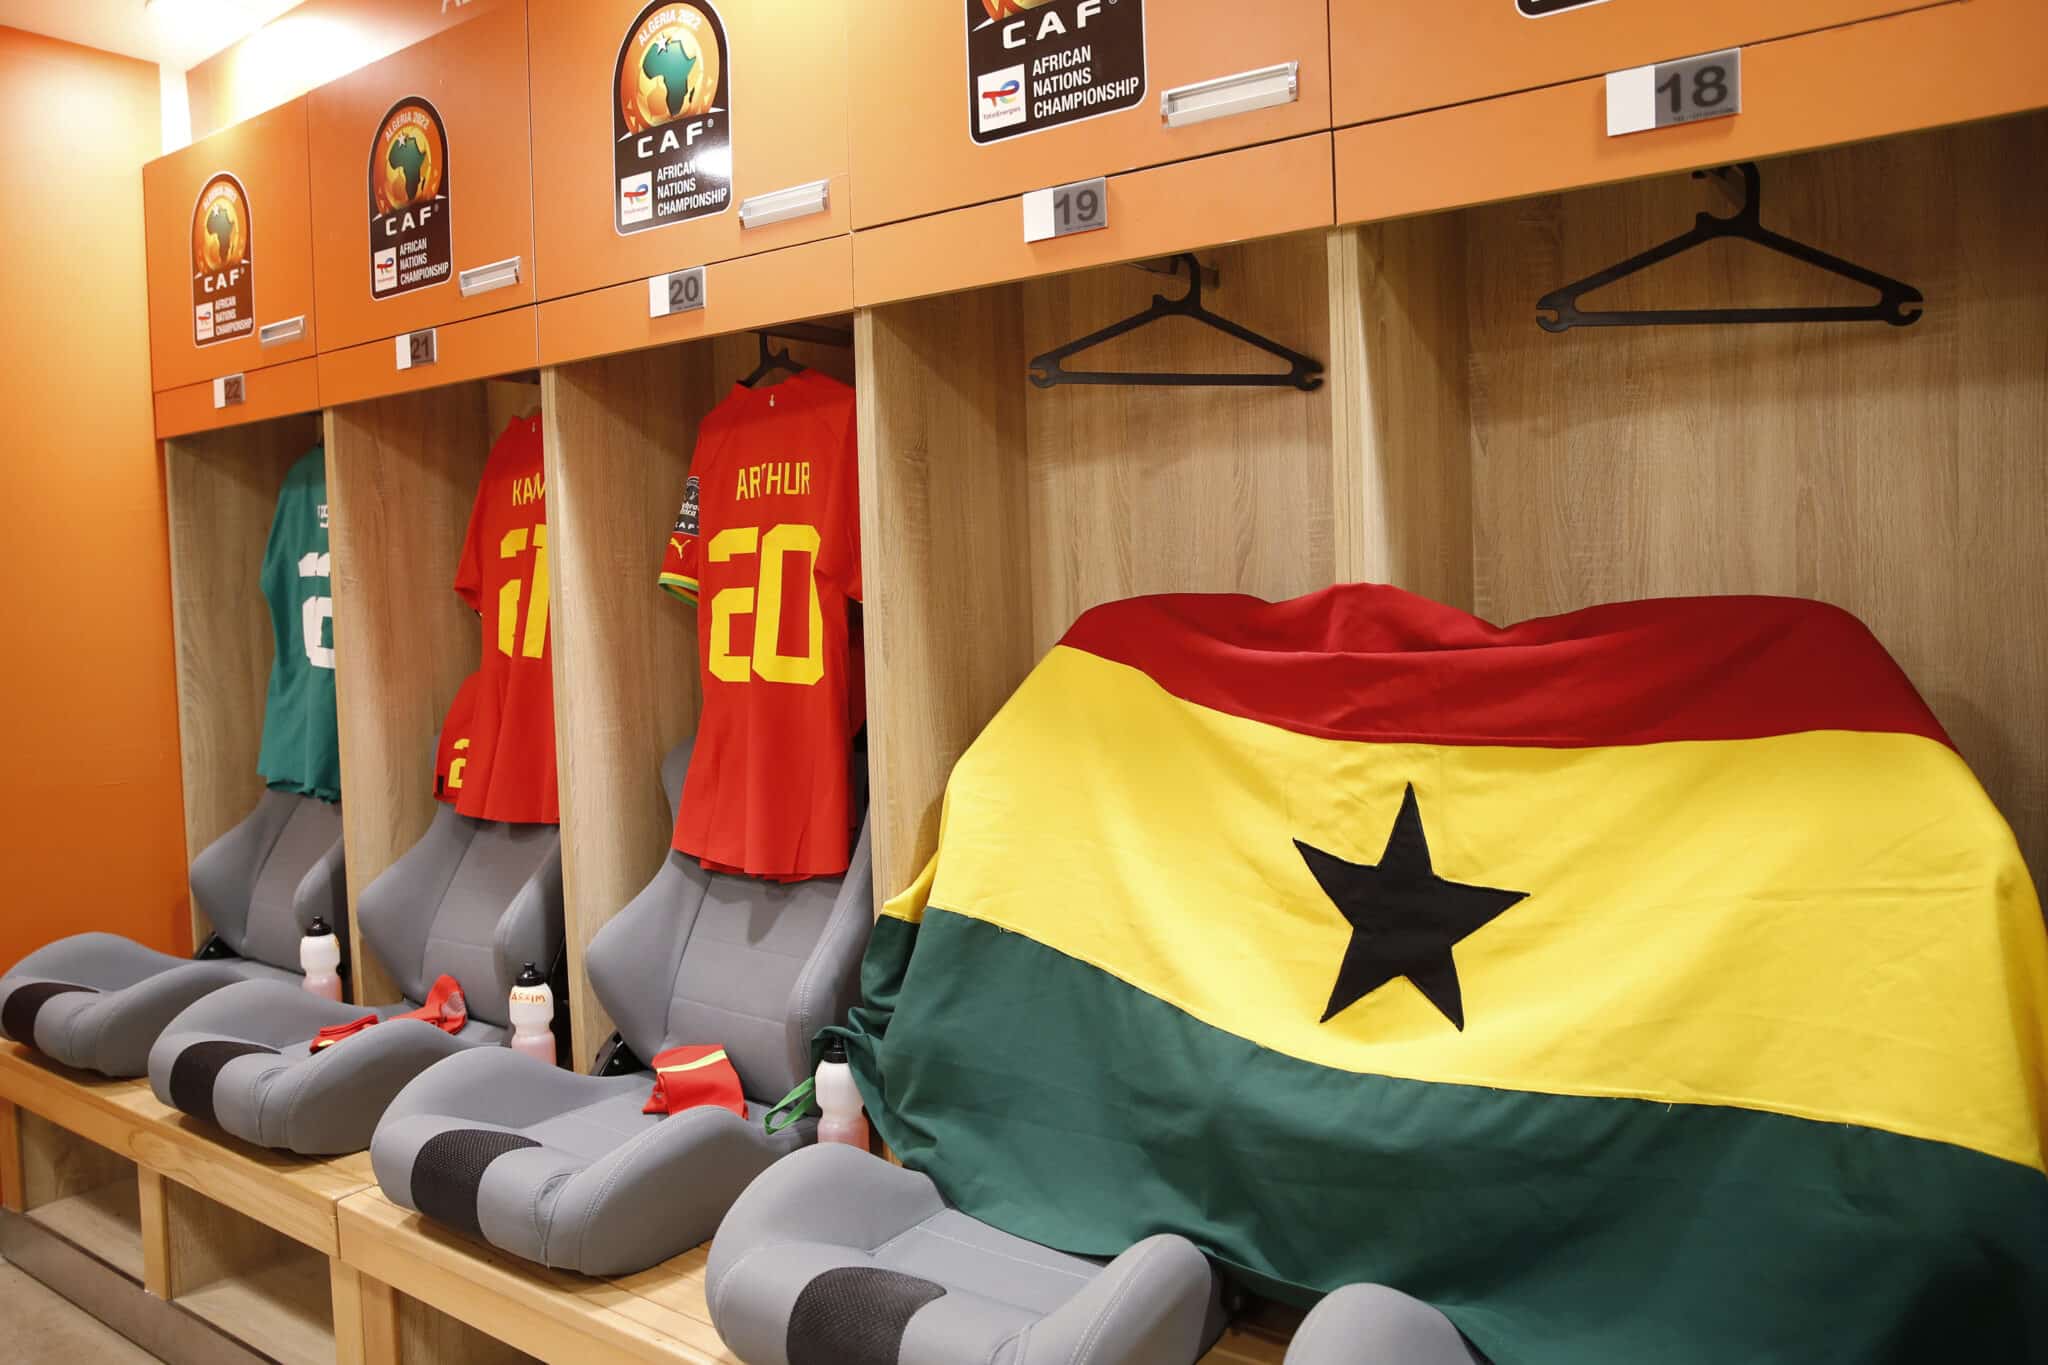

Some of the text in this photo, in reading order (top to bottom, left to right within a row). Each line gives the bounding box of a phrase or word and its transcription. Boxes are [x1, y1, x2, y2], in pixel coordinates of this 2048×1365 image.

[1002, 0, 1102, 49] CAF
[1032, 45, 1092, 76] AFRICAN
[1033, 67, 1092, 98] NATIONS
[1033, 76, 1140, 119] CHAMPIONSHIP
[1656, 65, 1729, 114] 18
[637, 121, 704, 158] CAF
[657, 159, 697, 182] AFRICAN
[657, 176, 697, 199] NATIONS
[657, 187, 728, 217] CHAMPIONSHIP
[385, 206, 432, 236] CAF
[1054, 189, 1098, 226] 19
[399, 237, 428, 257] AFRICAN
[399, 252, 428, 271] NATIONS
[204, 268, 240, 293] CAF
[400, 261, 449, 285] CHAMPIONSHIP
[669, 276, 699, 305] 20
[410, 336, 430, 359] 21
[736, 462, 810, 501] ARHUR
[708, 524, 825, 686] 20
